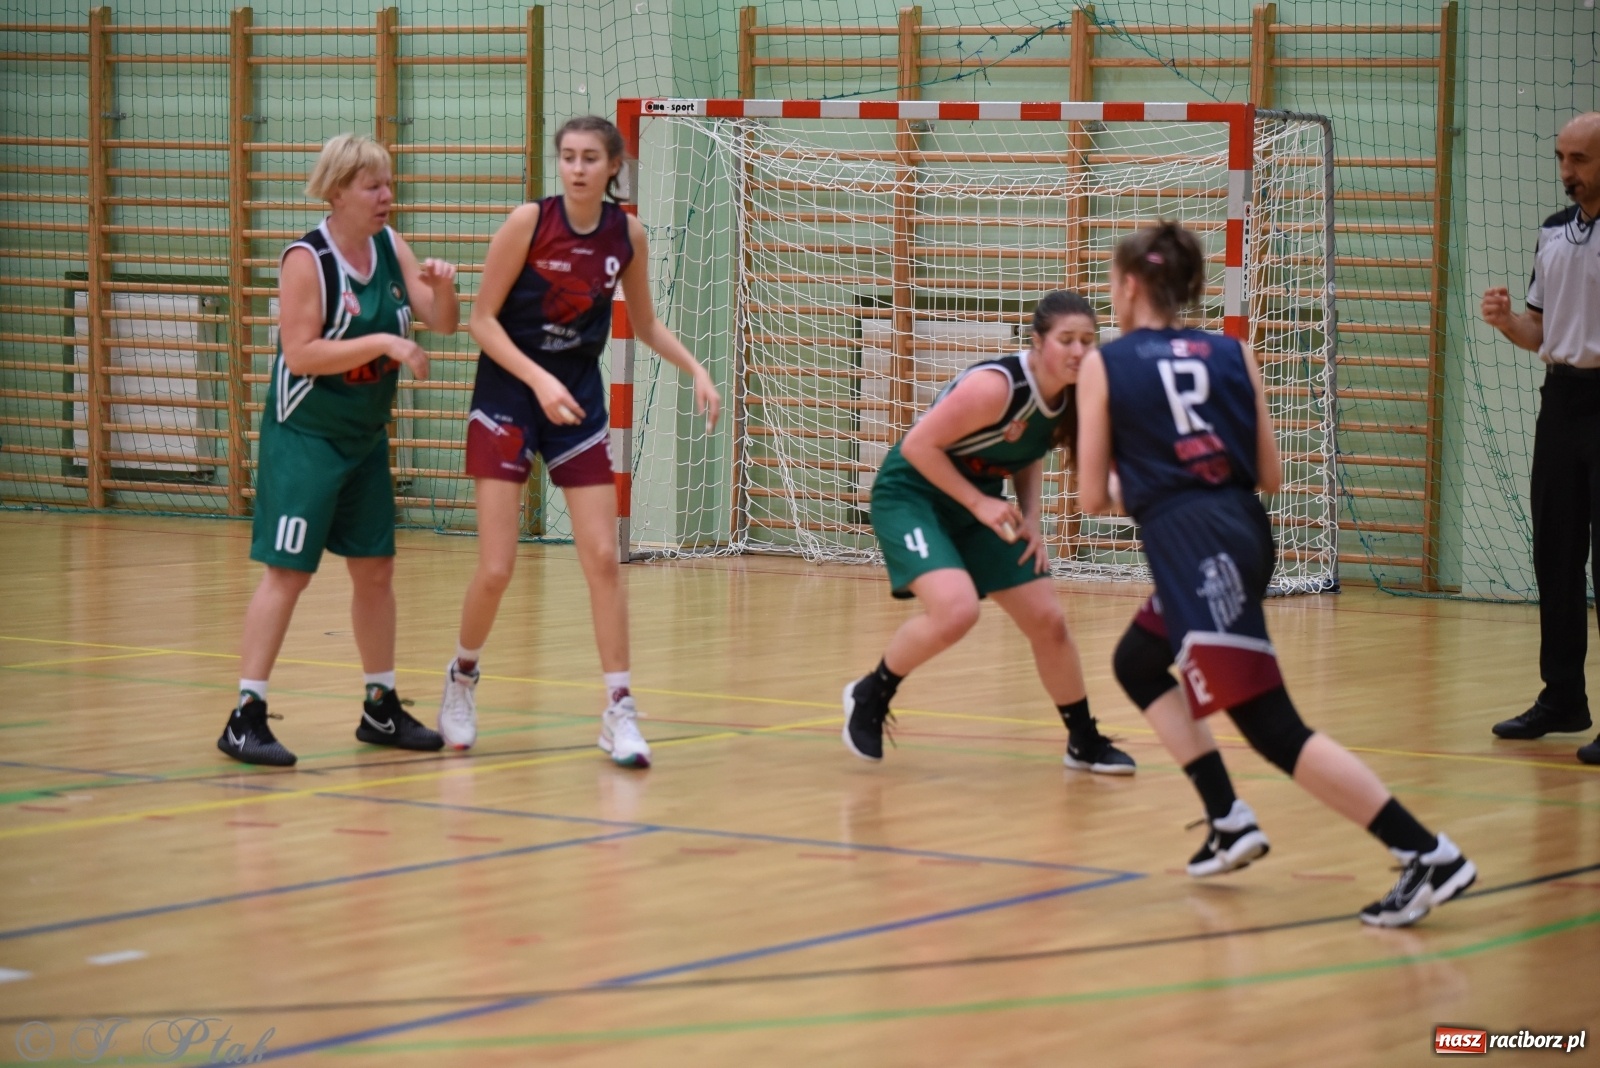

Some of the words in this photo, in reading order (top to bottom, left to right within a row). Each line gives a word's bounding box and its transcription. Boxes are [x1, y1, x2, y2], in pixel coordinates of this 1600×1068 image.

[671, 103, 694, 113] sport
[604, 255, 620, 289] 9
[274, 514, 308, 555] 10
[904, 527, 929, 560] 4
